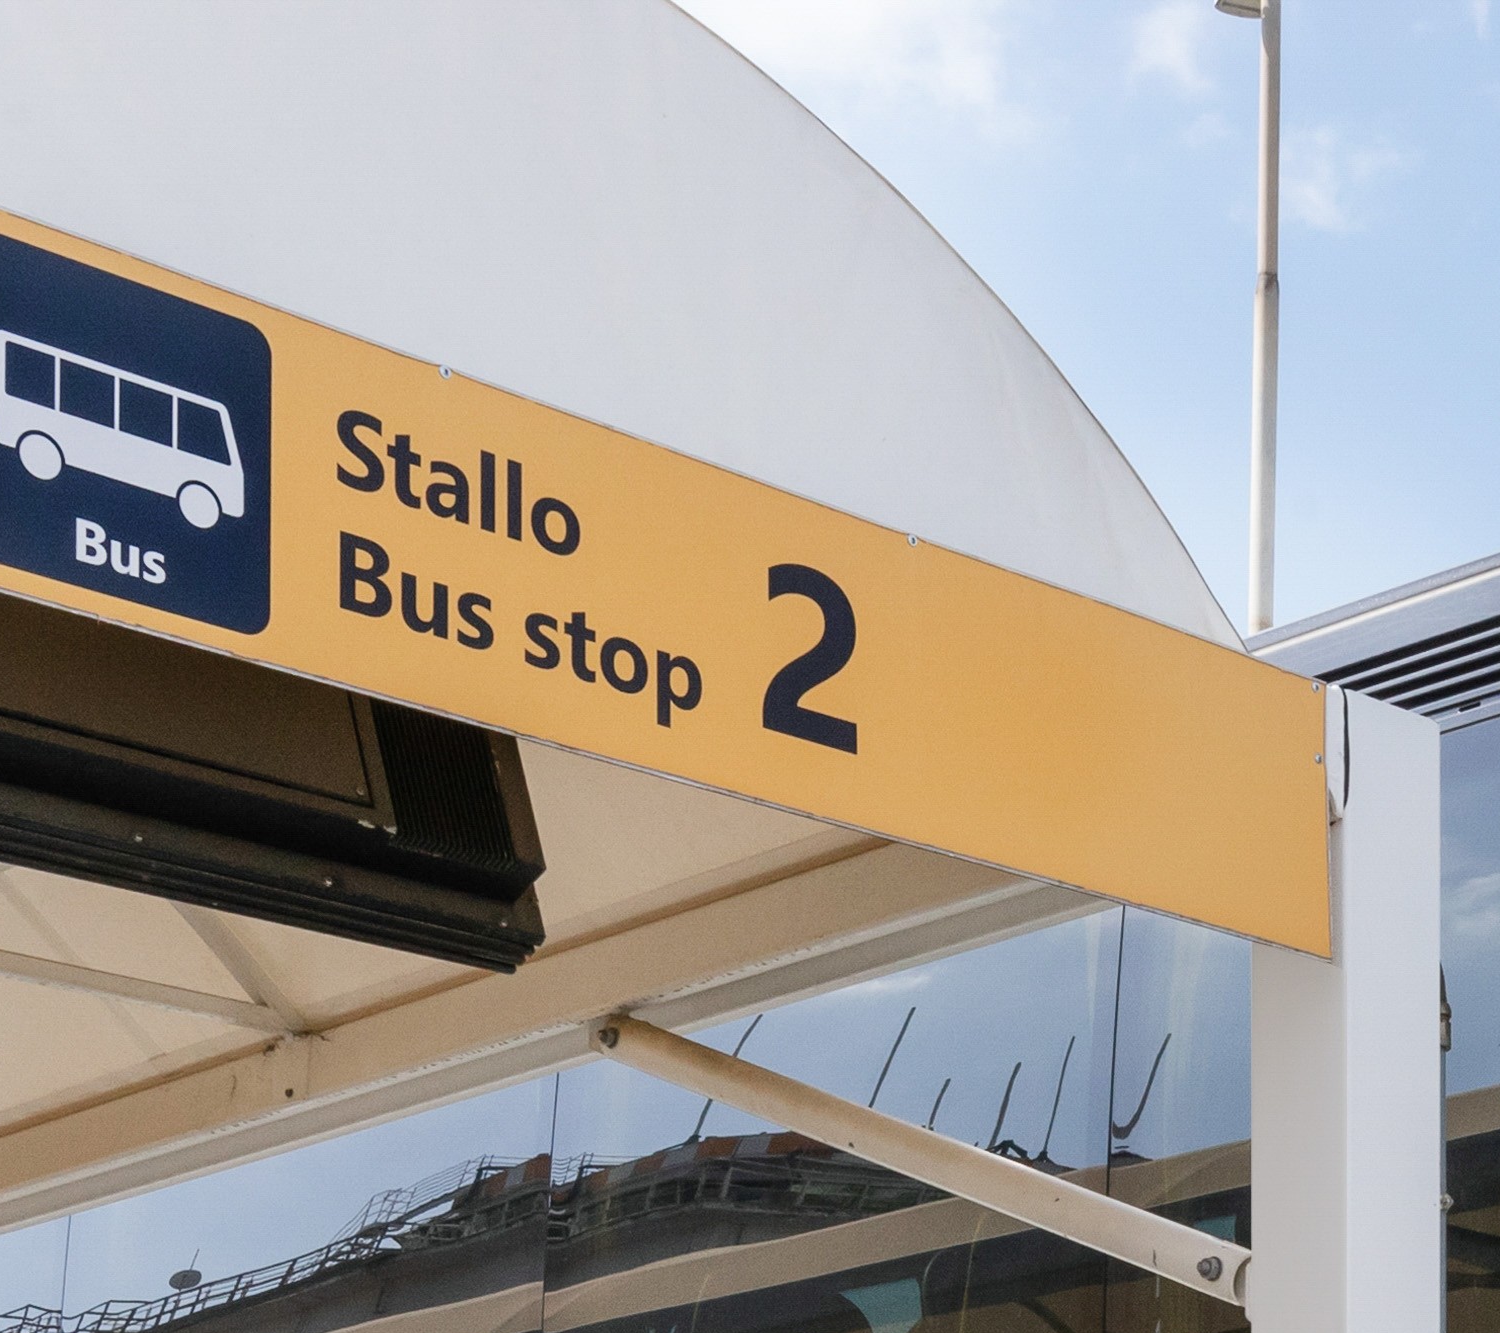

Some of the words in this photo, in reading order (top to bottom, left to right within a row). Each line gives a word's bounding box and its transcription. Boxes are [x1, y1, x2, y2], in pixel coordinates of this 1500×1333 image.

[74, 518, 167, 585] Bus
[336, 410, 582, 557] Stallo
[338, 531, 495, 651] Bus
[523, 610, 704, 727] stop
[761, 562, 858, 755] 2
